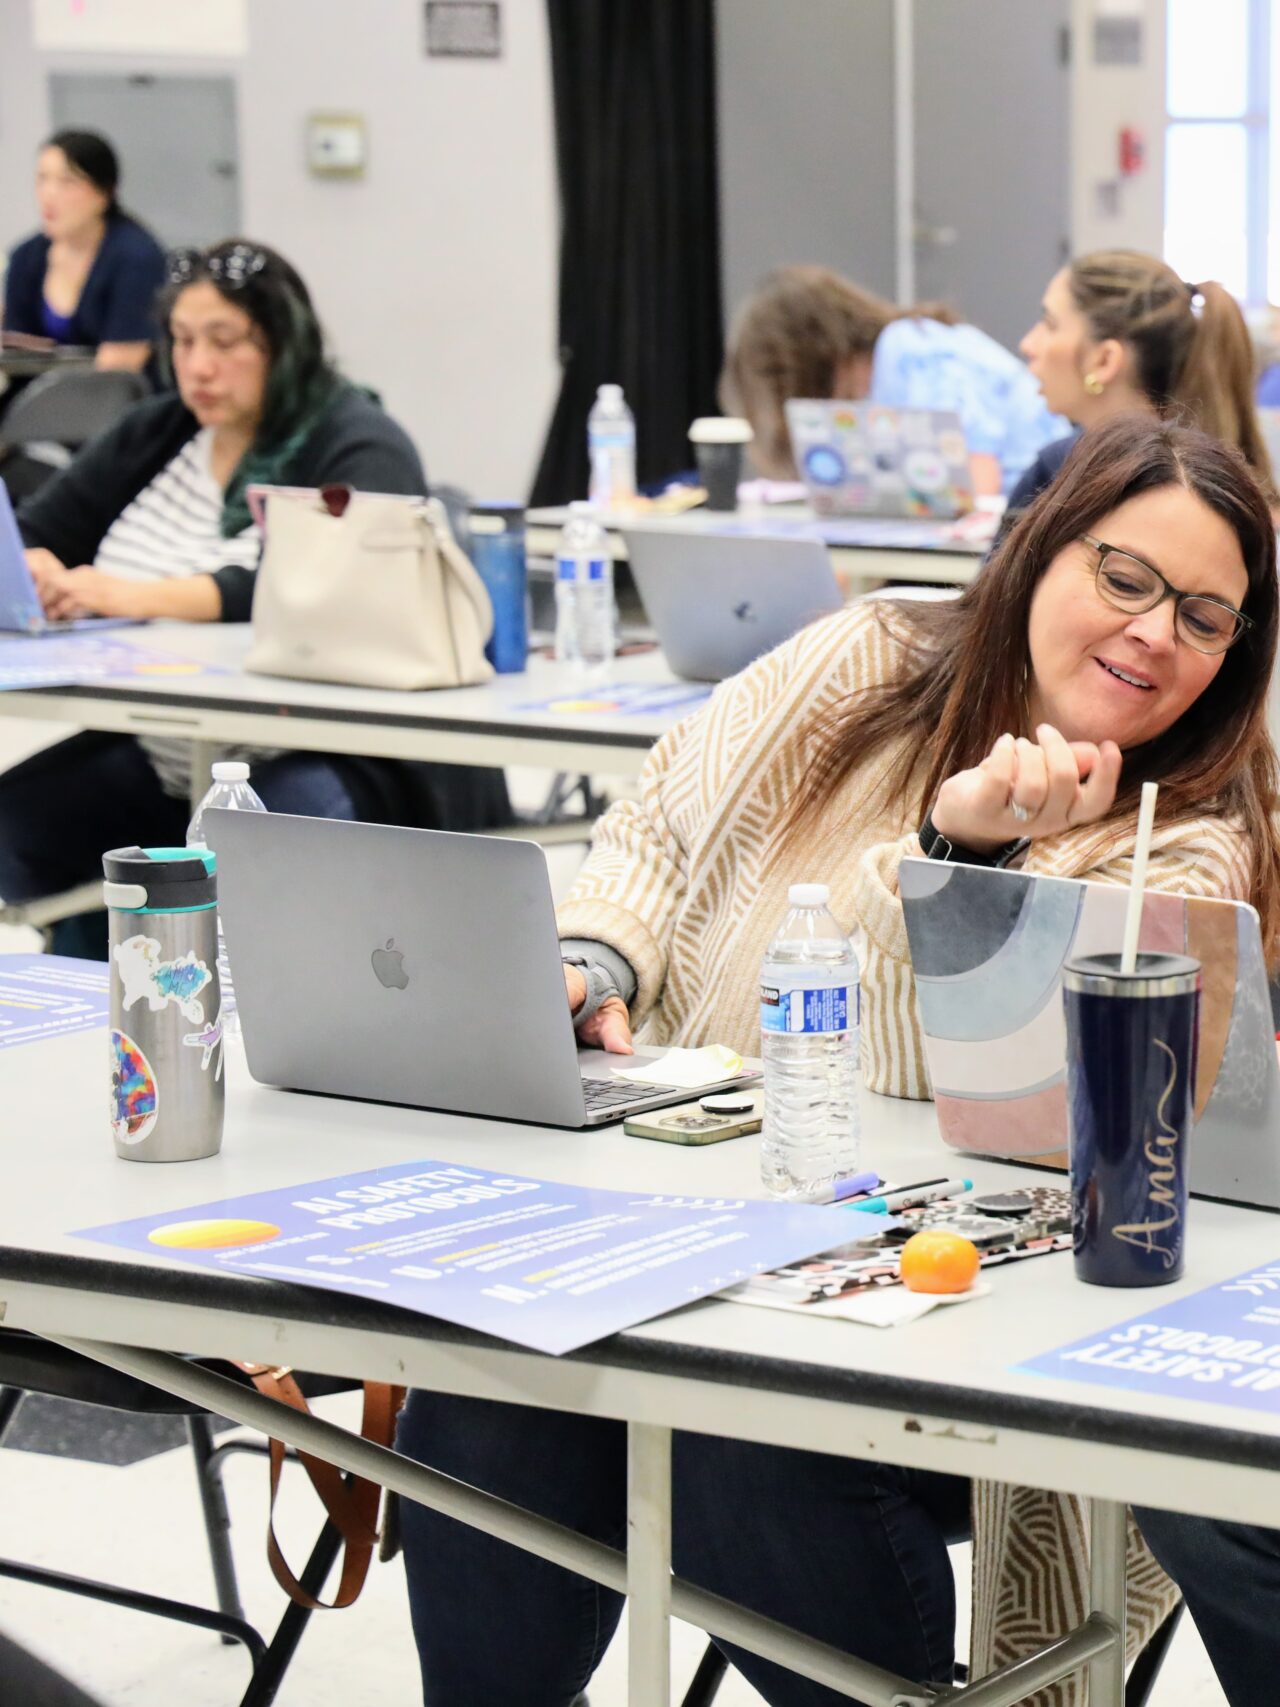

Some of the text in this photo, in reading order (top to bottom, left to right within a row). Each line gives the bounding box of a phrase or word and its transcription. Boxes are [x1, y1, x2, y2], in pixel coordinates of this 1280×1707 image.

[1111, 1038, 1180, 1270] Ana
[291, 1167, 485, 1215] AI SAFETY
[316, 1178, 541, 1231] PROTOCOLS
[1060, 1341, 1242, 1383] SAFETY
